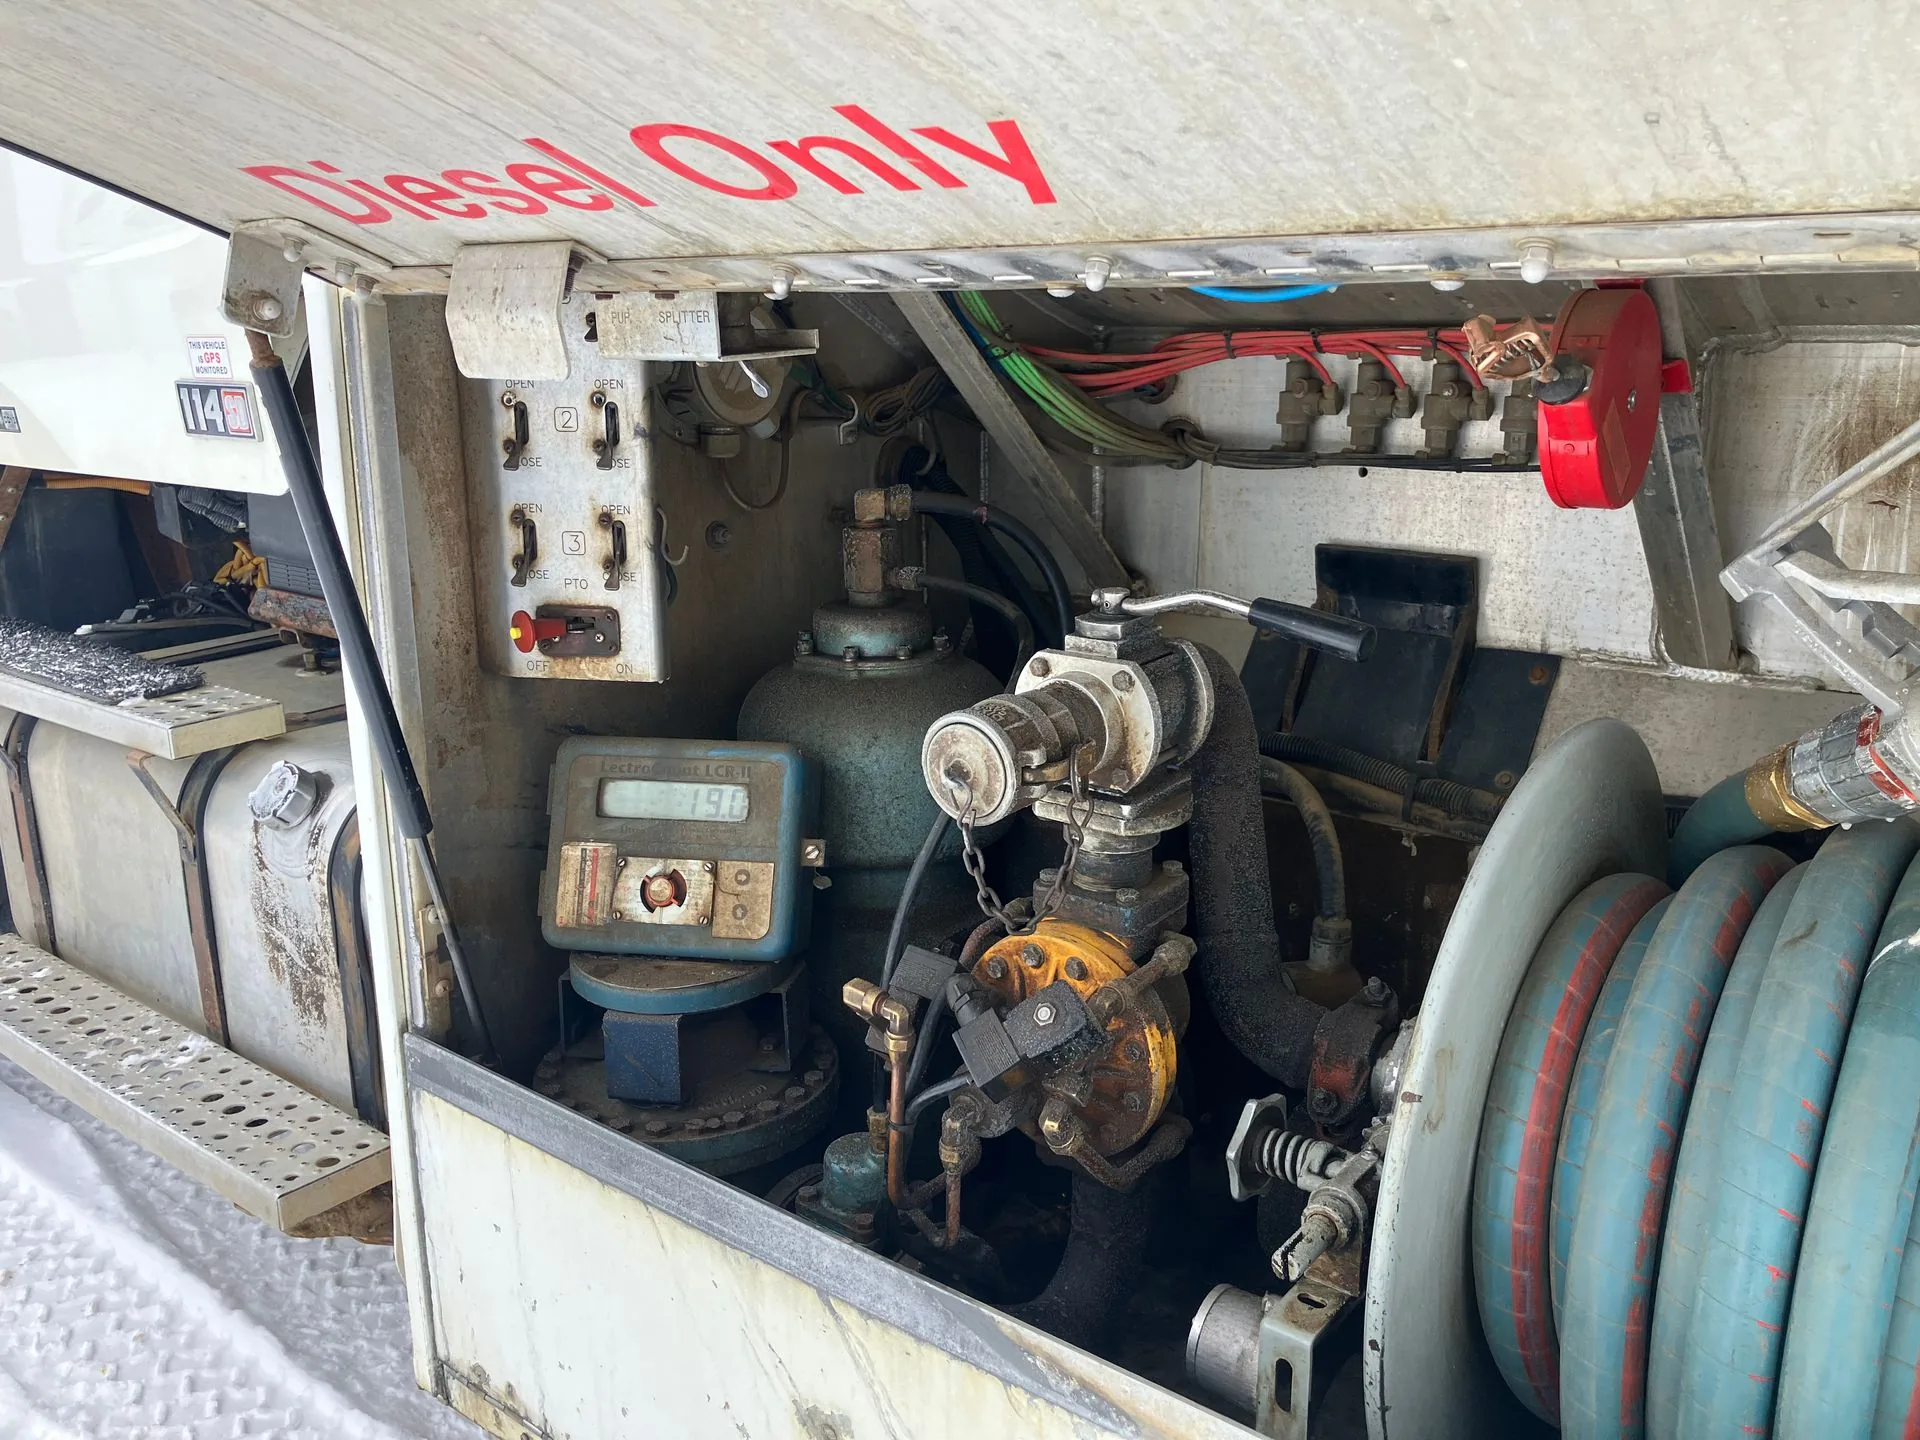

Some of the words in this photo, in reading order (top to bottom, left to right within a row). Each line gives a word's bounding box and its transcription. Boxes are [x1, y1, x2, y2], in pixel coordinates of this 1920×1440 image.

[238, 138, 658, 225] Diesel
[629, 104, 1058, 205] Only
[658, 310, 711, 324] SPLITTER
[188, 341, 202, 349] THIS
[202, 341, 226, 350] VEHICLE
[197, 355, 204, 364] IS
[203, 352, 221, 363] GPS
[195, 366, 228, 375] MONITORED
[505, 379, 535, 389] OPEN
[593, 379, 624, 389] OPEN
[180, 387, 225, 433] 114
[561, 410, 573, 429] 2
[568, 534, 581, 552] 3
[602, 571, 636, 581] COSE
[564, 577, 589, 590] PTO
[526, 660, 549, 671] OFF
[615, 663, 633, 674] ON
